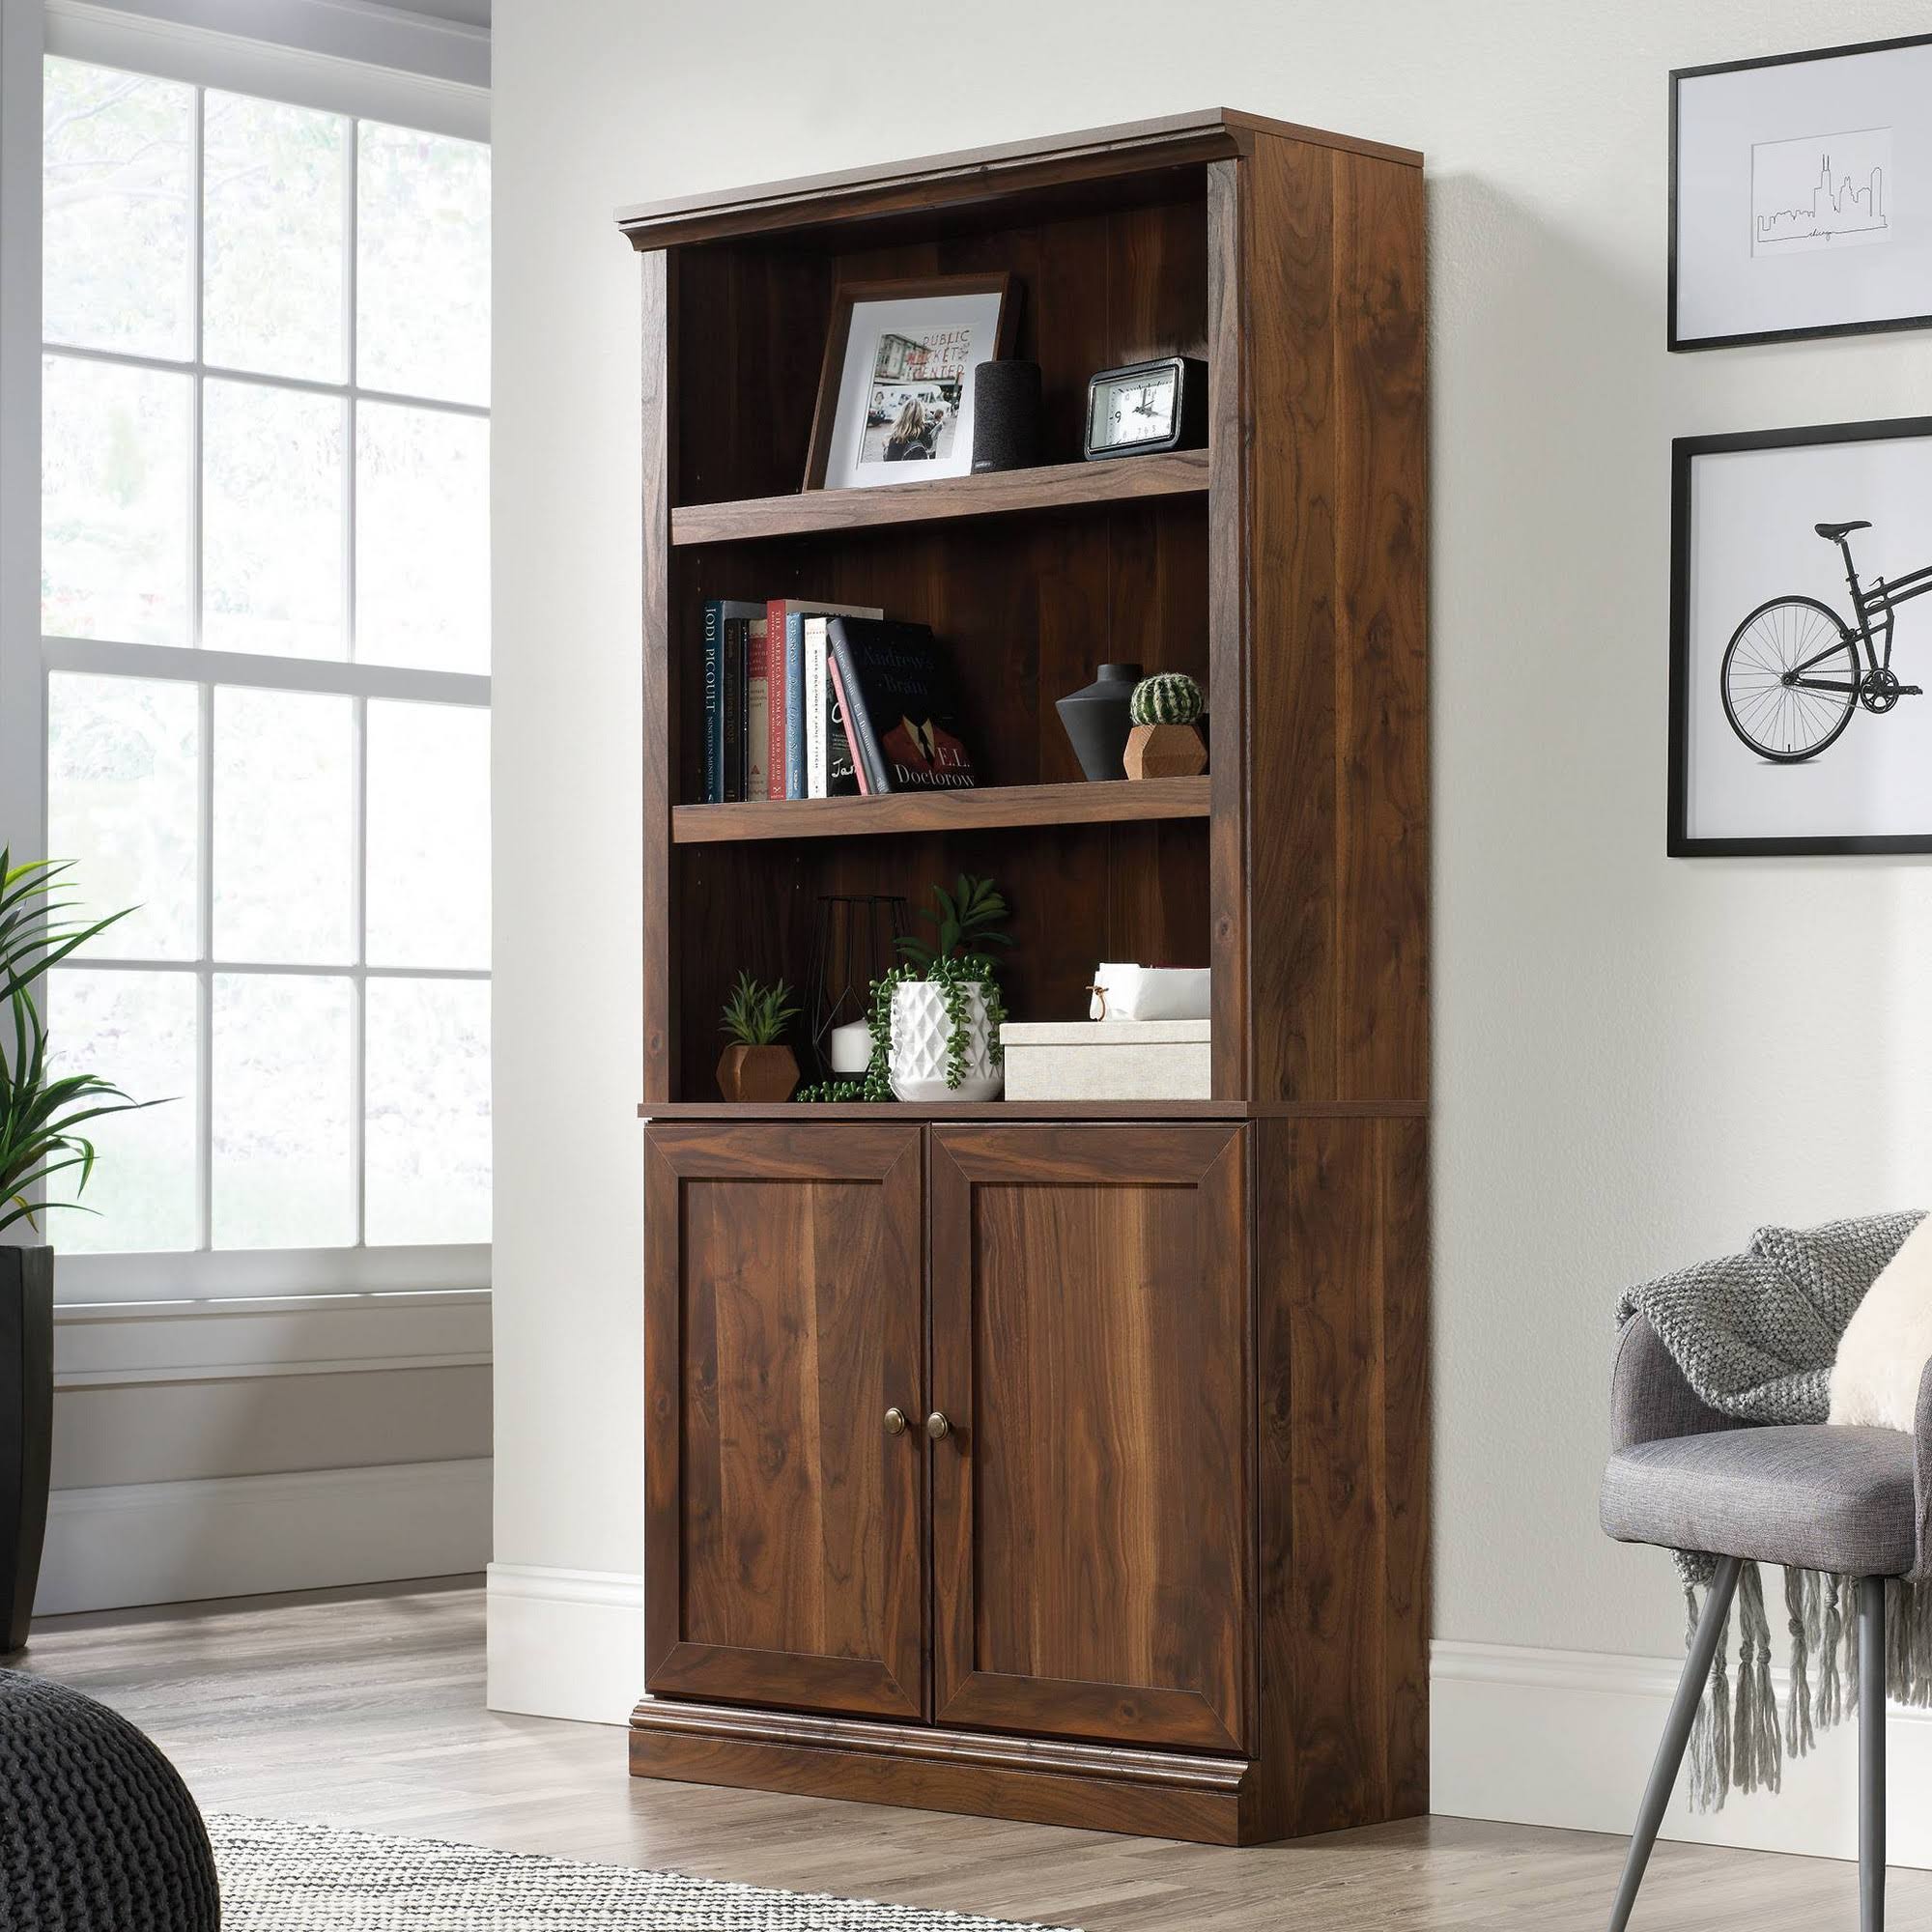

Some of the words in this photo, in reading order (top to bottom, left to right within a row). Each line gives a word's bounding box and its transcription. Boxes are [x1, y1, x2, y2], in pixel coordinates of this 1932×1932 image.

[1806, 228, 1833, 242] chicago
[923, 329, 970, 347] PUBLIC
[1114, 411, 1122, 424] 9
[705, 607, 717, 641] JODI
[705, 648, 716, 713] PICOULT
[881, 673, 928, 696] Brain
[846, 673, 857, 696] Brain
[860, 720, 873, 757] Doctorow
[936, 747, 970, 767] E.L.
[893, 764, 975, 787] Doctorow
